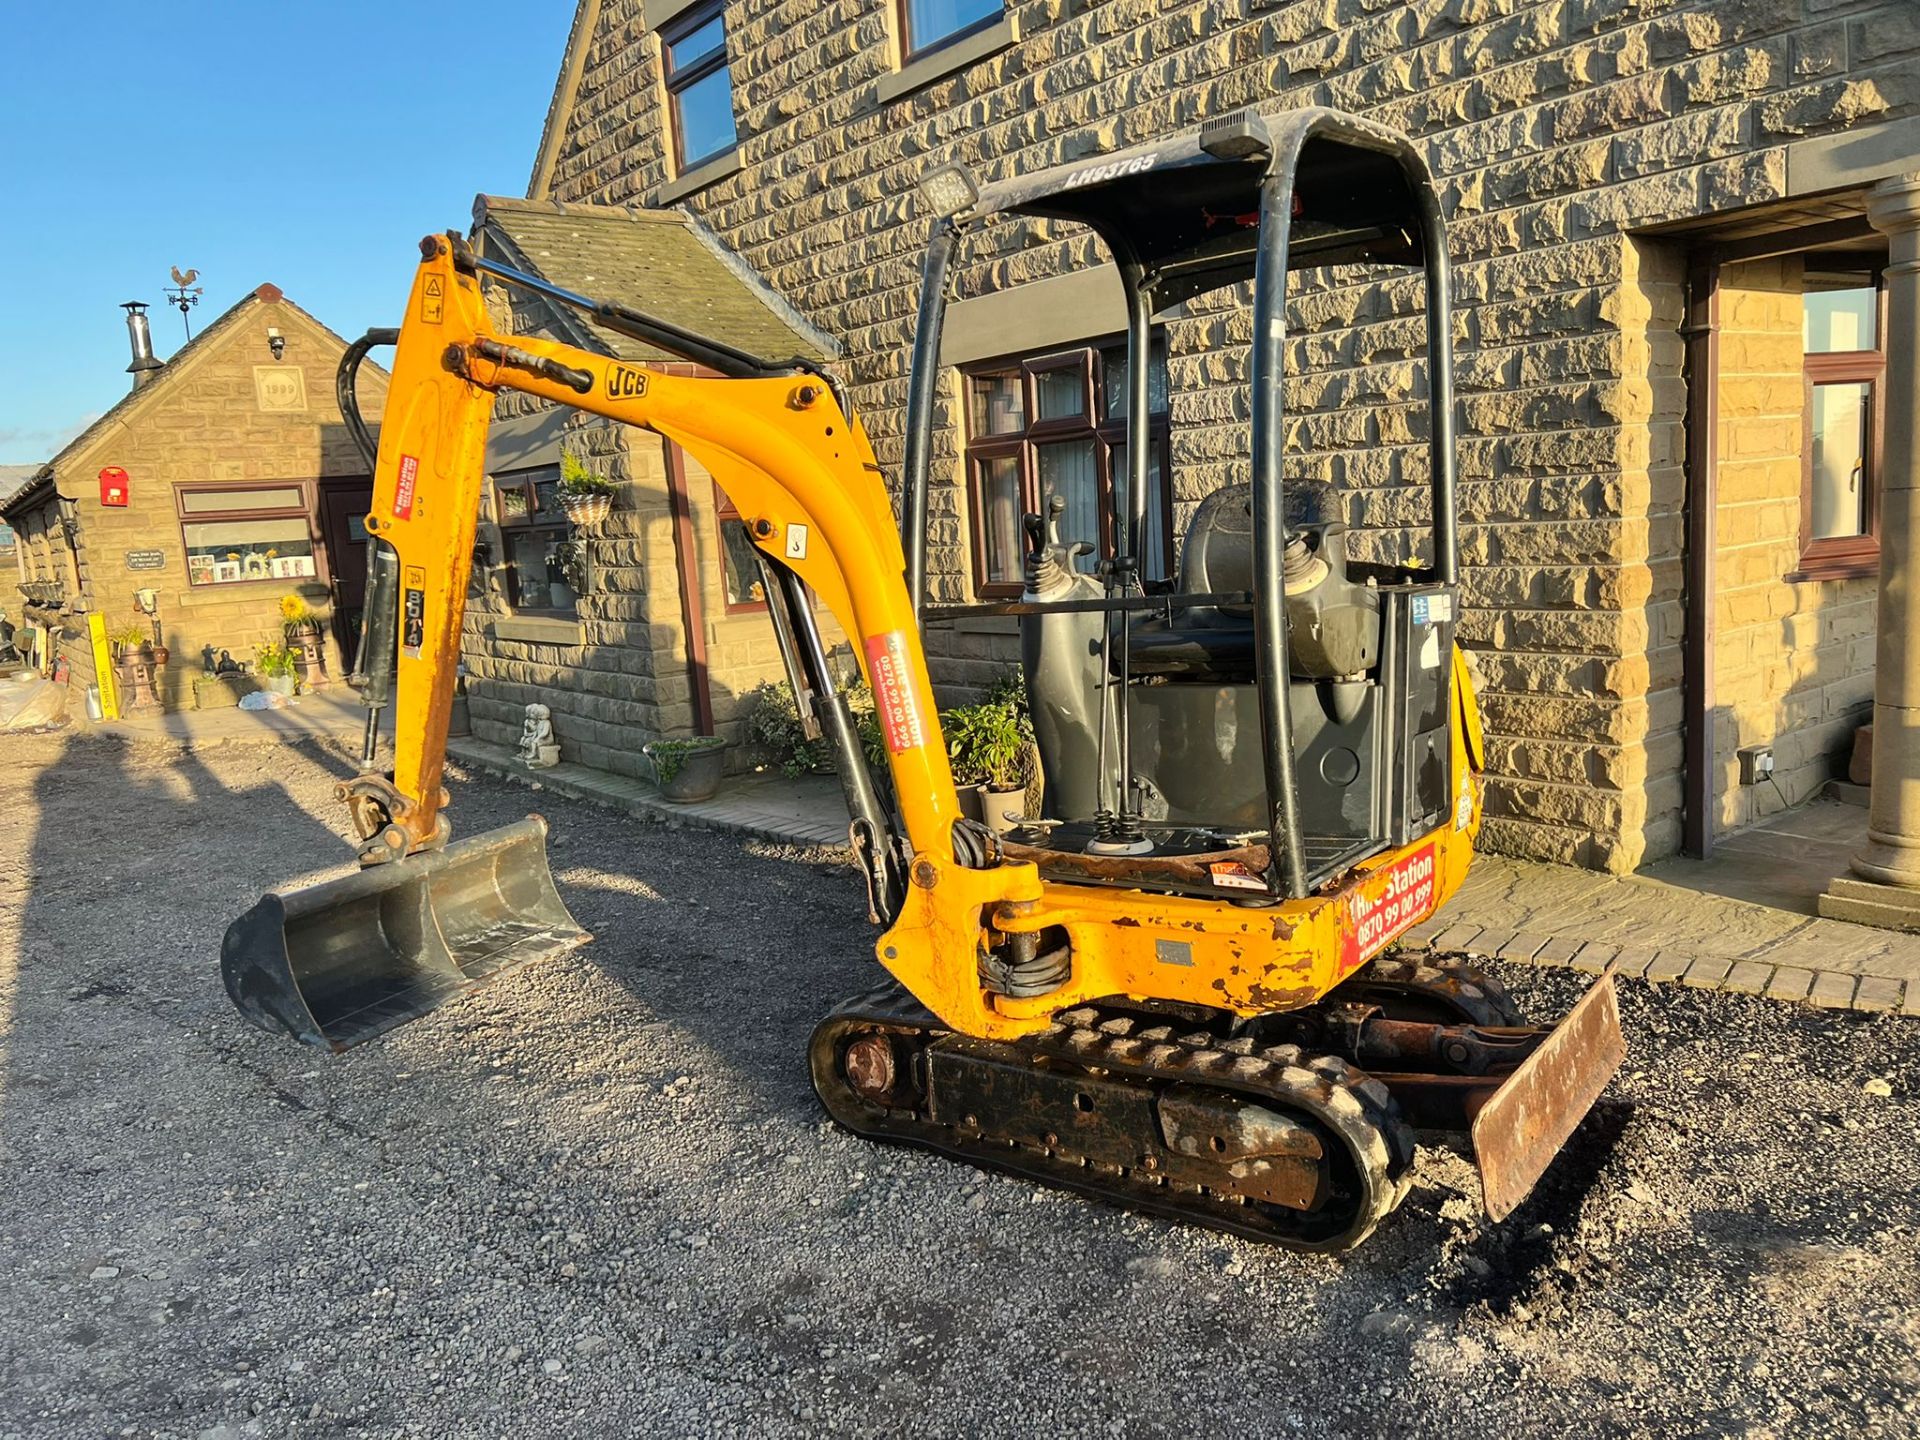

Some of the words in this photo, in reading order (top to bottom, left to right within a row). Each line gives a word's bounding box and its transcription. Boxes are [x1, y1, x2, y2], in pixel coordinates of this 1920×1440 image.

[1063, 153, 1158, 190] LH93765
[265, 384, 295, 394] 1999
[609, 366, 646, 396] JCB
[880, 655, 895, 686] 0870
[101, 671, 112, 709] Sanitation
[889, 688, 900, 704] 99
[894, 707, 904, 722] 00
[900, 688, 924, 746] Station
[898, 725, 911, 748] 999
[1386, 856, 1432, 900] Station
[1358, 912, 1383, 946] 0870
[1385, 902, 1399, 927] 99
[1401, 893, 1413, 916] 00
[1415, 880, 1432, 906] 999
